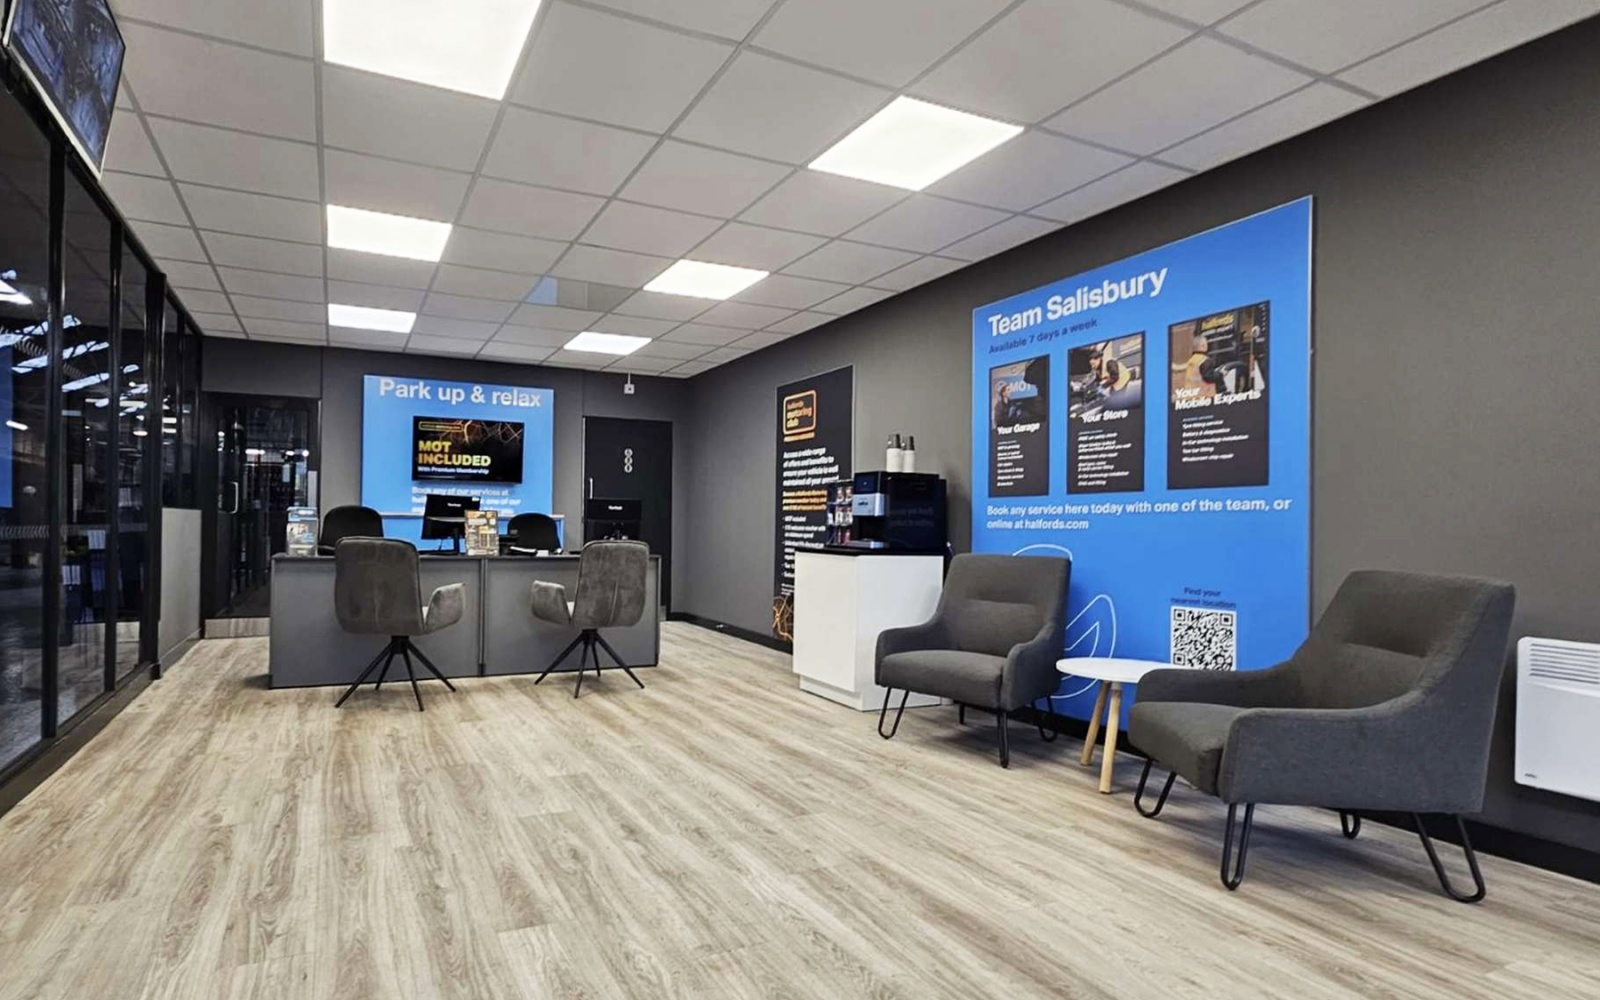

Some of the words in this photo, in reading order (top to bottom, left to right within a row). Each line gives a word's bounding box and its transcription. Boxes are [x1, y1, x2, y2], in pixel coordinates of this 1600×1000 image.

[988, 307, 1042, 337] Team
[1046, 266, 1168, 320] Salisbury
[988, 337, 1027, 354] Available
[1029, 335, 1035, 344] 7
[1036, 329, 1060, 343] days
[1061, 326, 1068, 335] a
[1070, 318, 1098, 333] week
[379, 378, 431, 400] Park
[438, 385, 465, 405] up
[470, 385, 485, 404] &
[492, 388, 541, 407] relax
[1175, 387, 1200, 399] Your
[1174, 397, 1212, 410] Mobile
[1213, 389, 1261, 405] Experts
[1080, 413, 1102, 423] Your
[1103, 410, 1129, 421] Store
[997, 426, 1013, 435] Your
[1013, 422, 1040, 433] Garage
[418, 440, 452, 452] MOT
[417, 453, 491, 467] INCLUDED
[469, 488, 500, 497] services
[987, 505, 1009, 516] Book
[1009, 506, 1025, 517] any
[1027, 504, 1063, 515] service
[1065, 503, 1089, 514] here
[1090, 503, 1123, 516] today
[1126, 501, 1151, 513] with
[1154, 502, 1179, 512] one
[1181, 499, 1197, 512] of
[1199, 498, 1223, 511] the
[1226, 498, 1269, 511] team,
[1273, 499, 1292, 510] or
[987, 519, 1013, 529] online
[1014, 520, 1024, 529] at
[1025, 519, 1089, 529] halfords.com
[1184, 587, 1201, 595] Find
